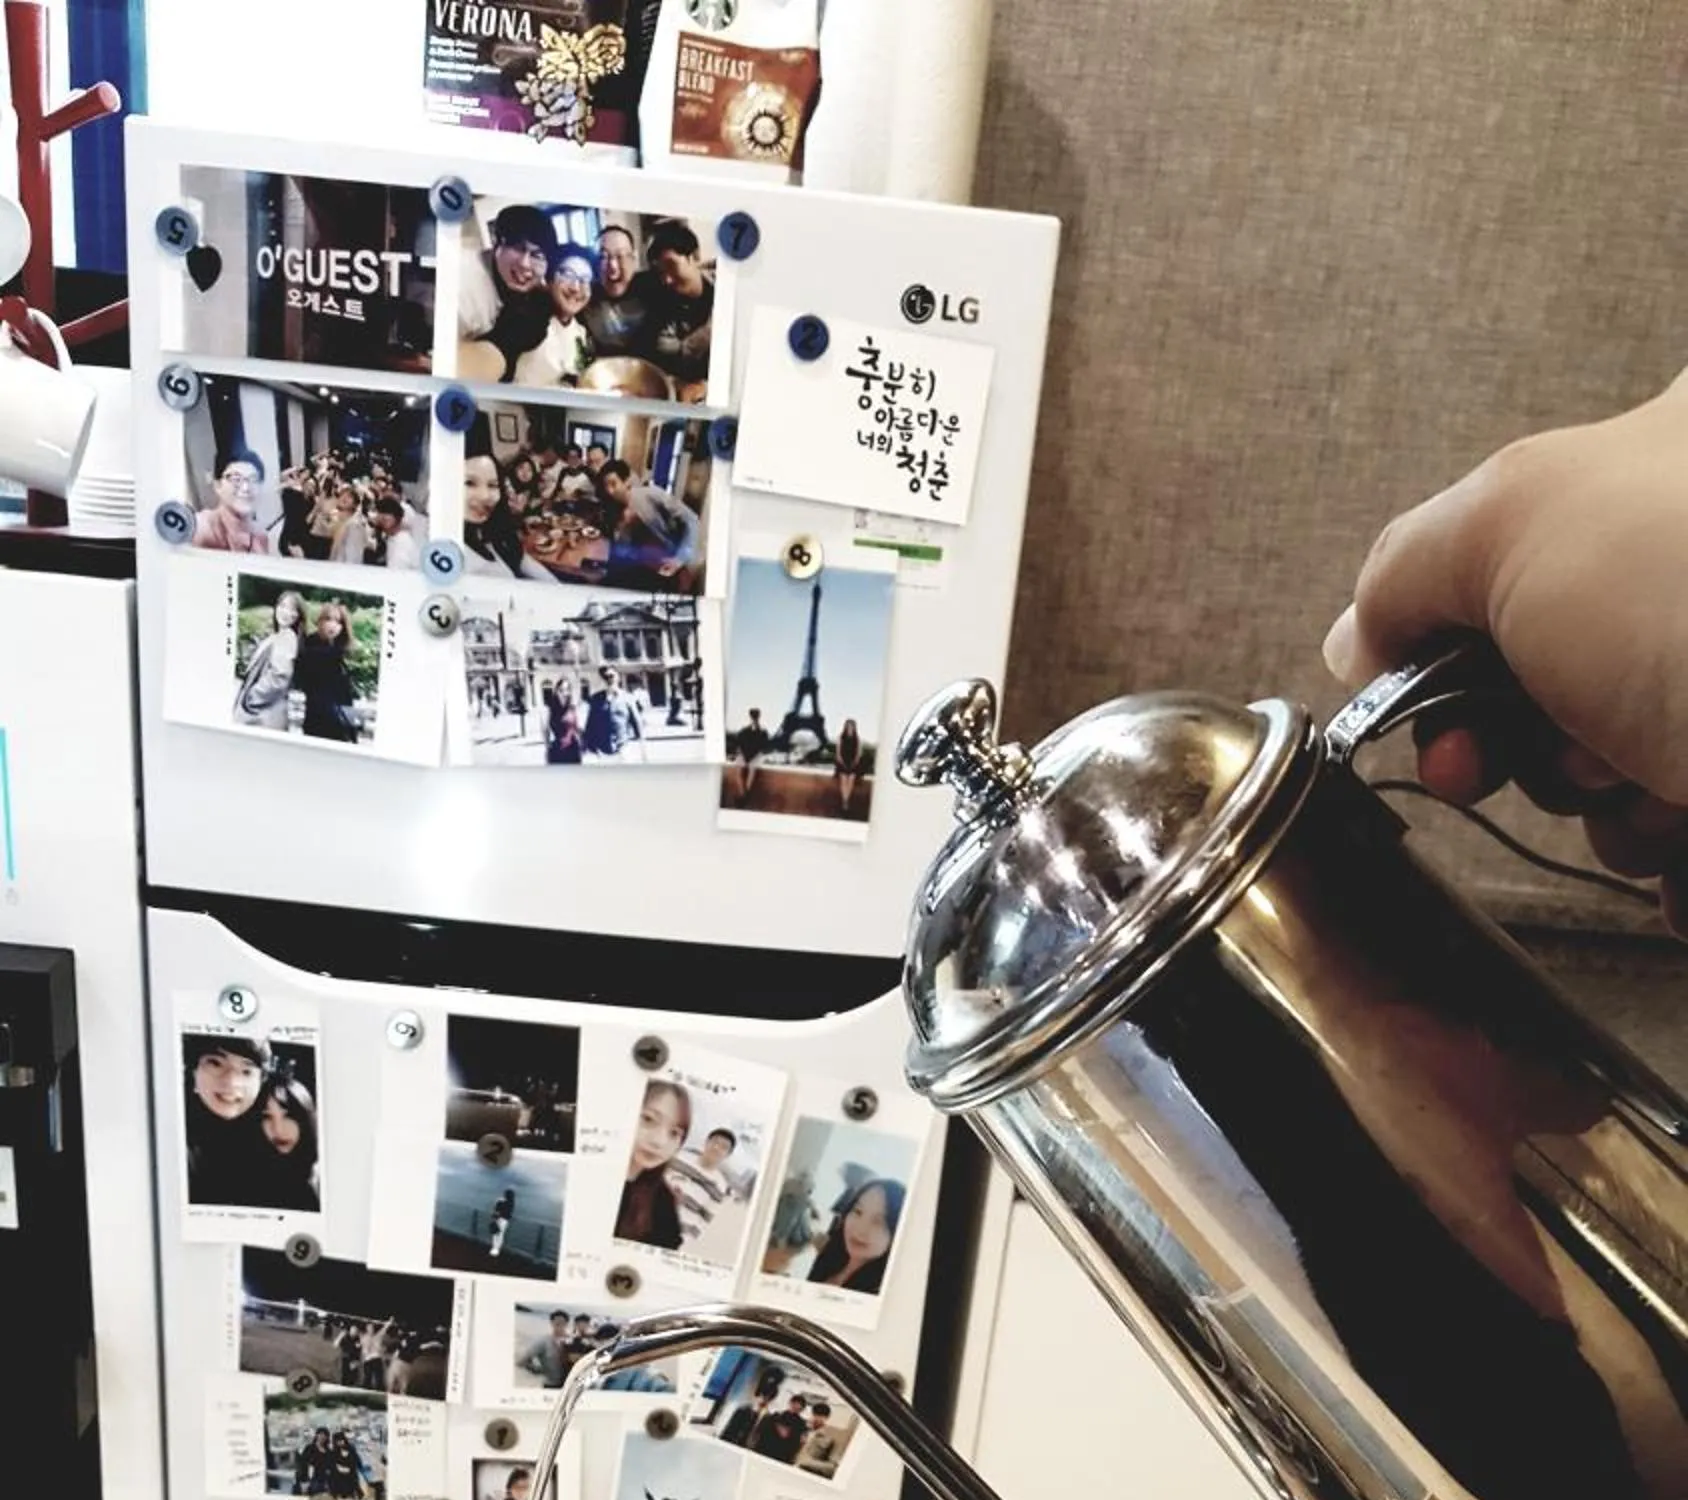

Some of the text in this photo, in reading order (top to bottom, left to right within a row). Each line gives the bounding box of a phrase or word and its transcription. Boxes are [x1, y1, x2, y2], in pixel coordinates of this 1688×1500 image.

[435, 0, 533, 43] VERONA
[681, 46, 754, 81] BREAKFAST
[678, 69, 715, 94] BLEND
[729, 219, 749, 252] 7
[256, 245, 412, 297] O'GUEST
[286, 289, 366, 322] 오게스트
[941, 294, 981, 323] LG
[798, 321, 820, 351] 2
[845, 336, 937, 410] 충분히
[874, 406, 961, 446] 아름다운
[856, 430, 950, 501] 너의 청춘
[789, 543, 812, 567] 8
[230, 991, 245, 1014] 8
[853, 1091, 872, 1114] 5
[483, 1141, 504, 1163] 2
